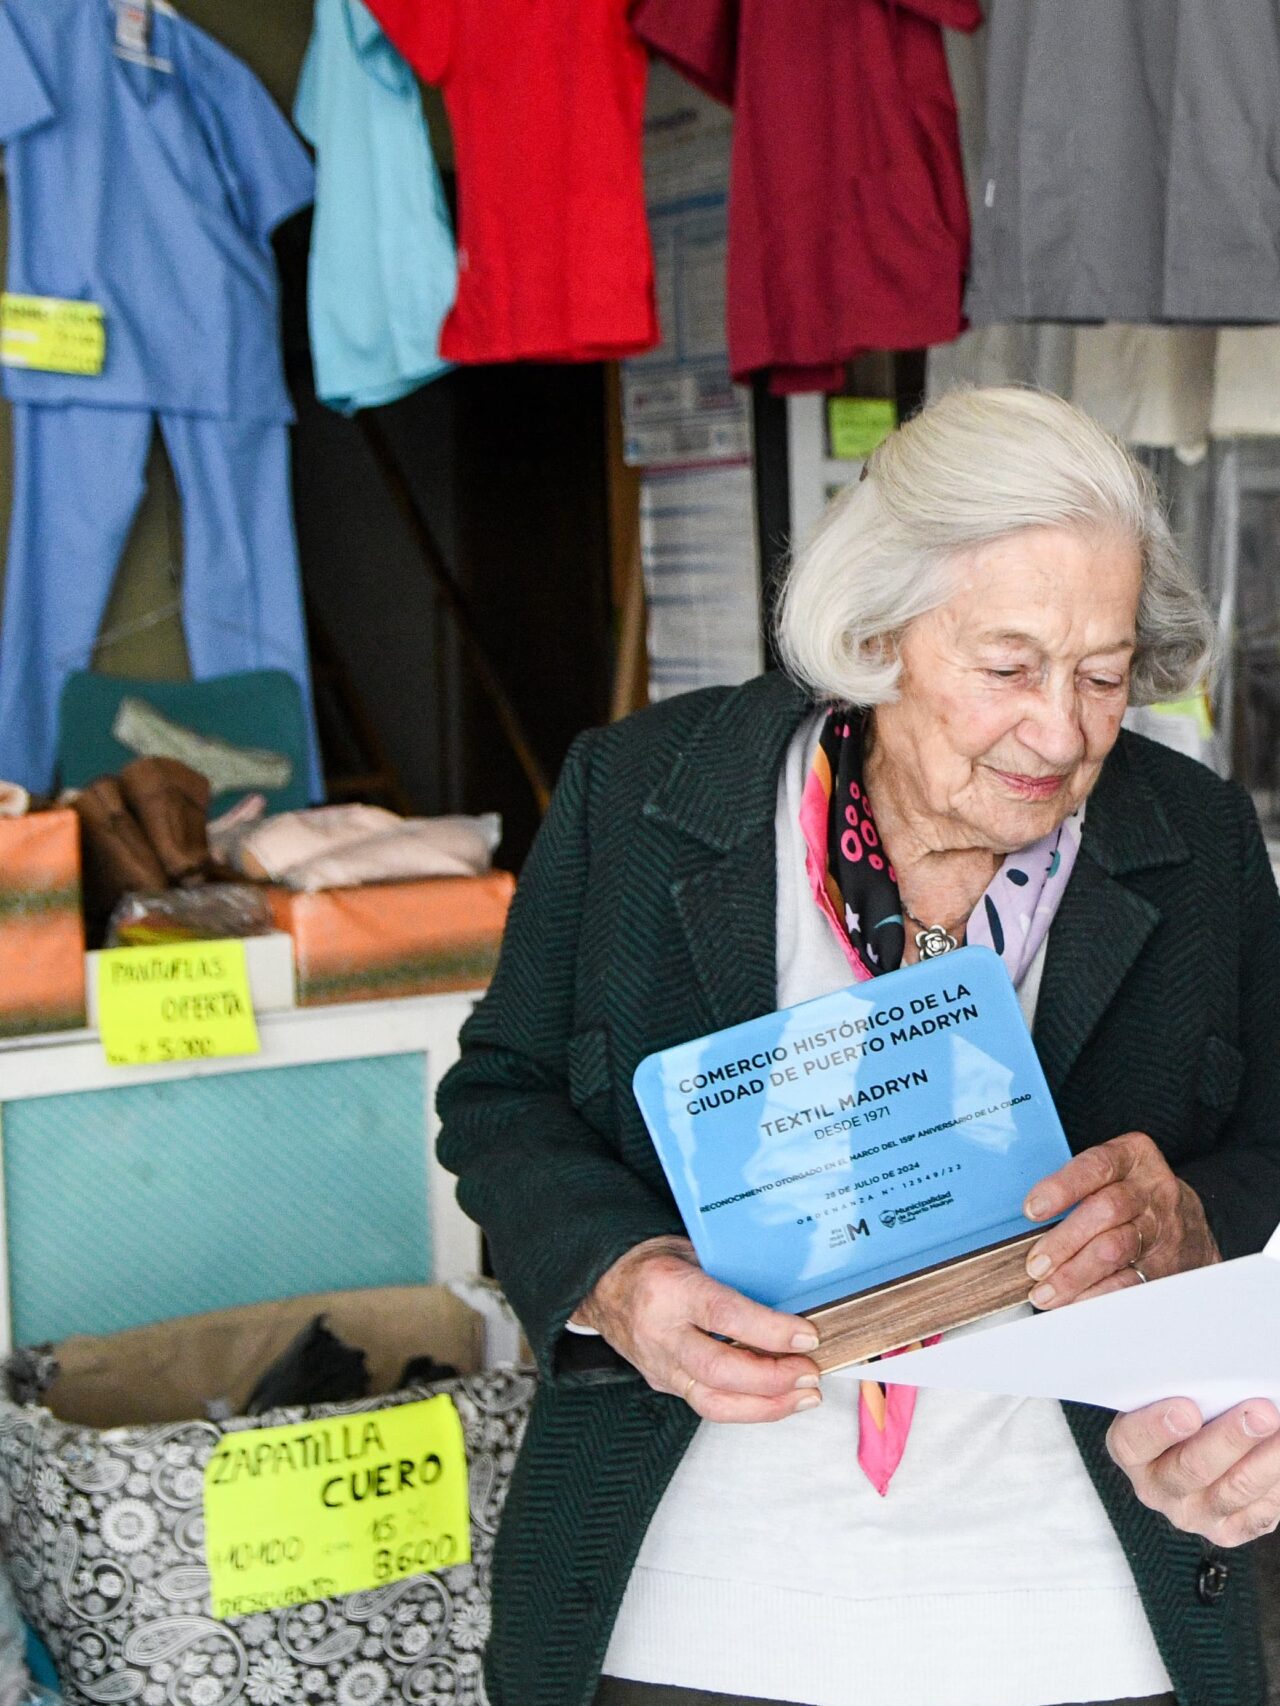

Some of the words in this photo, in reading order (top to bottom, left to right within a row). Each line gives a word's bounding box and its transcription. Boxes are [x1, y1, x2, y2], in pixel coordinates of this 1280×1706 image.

[161, 990, 244, 1022] OFERTA
[679, 1047, 788, 1094] COMERCIO
[793, 1005, 904, 1056] HISTÓRICO
[910, 993, 939, 1015] DE
[943, 984, 971, 1003] LA
[686, 1078, 764, 1116] CIUDAD
[770, 1066, 799, 1088] DE
[805, 1036, 885, 1077] PUERTO
[890, 1003, 979, 1047] MADRYN
[761, 1103, 834, 1138] TEXTIL
[838, 1068, 929, 1112] MADRYN
[814, 1115, 860, 1141] DESDE
[864, 1105, 891, 1124] 1971
[700, 1183, 774, 1213] RECONOCIMIENTO
[775, 1166, 823, 1188] OTORGADO
[824, 1161, 836, 1171] EN
[838, 1158, 849, 1167] EL
[850, 1146, 880, 1162] MARCO
[881, 1140, 898, 1151] DEL
[917, 1114, 973, 1138] ANIVERSARIO
[974, 1108, 987, 1119] DE
[988, 1105, 1000, 1115] LA
[1000, 1093, 1032, 1110] CIUDAD
[824, 1190, 836, 1200] 28
[838, 1185, 851, 1196] DE
[854, 1175, 881, 1190] JULIO
[882, 1170, 896, 1181] DE
[897, 1161, 920, 1176] 2024
[895, 1191, 952, 1215] Municipalidad
[211, 1421, 386, 1485] ZAPATILLA
[321, 1453, 443, 1509] CUERO
